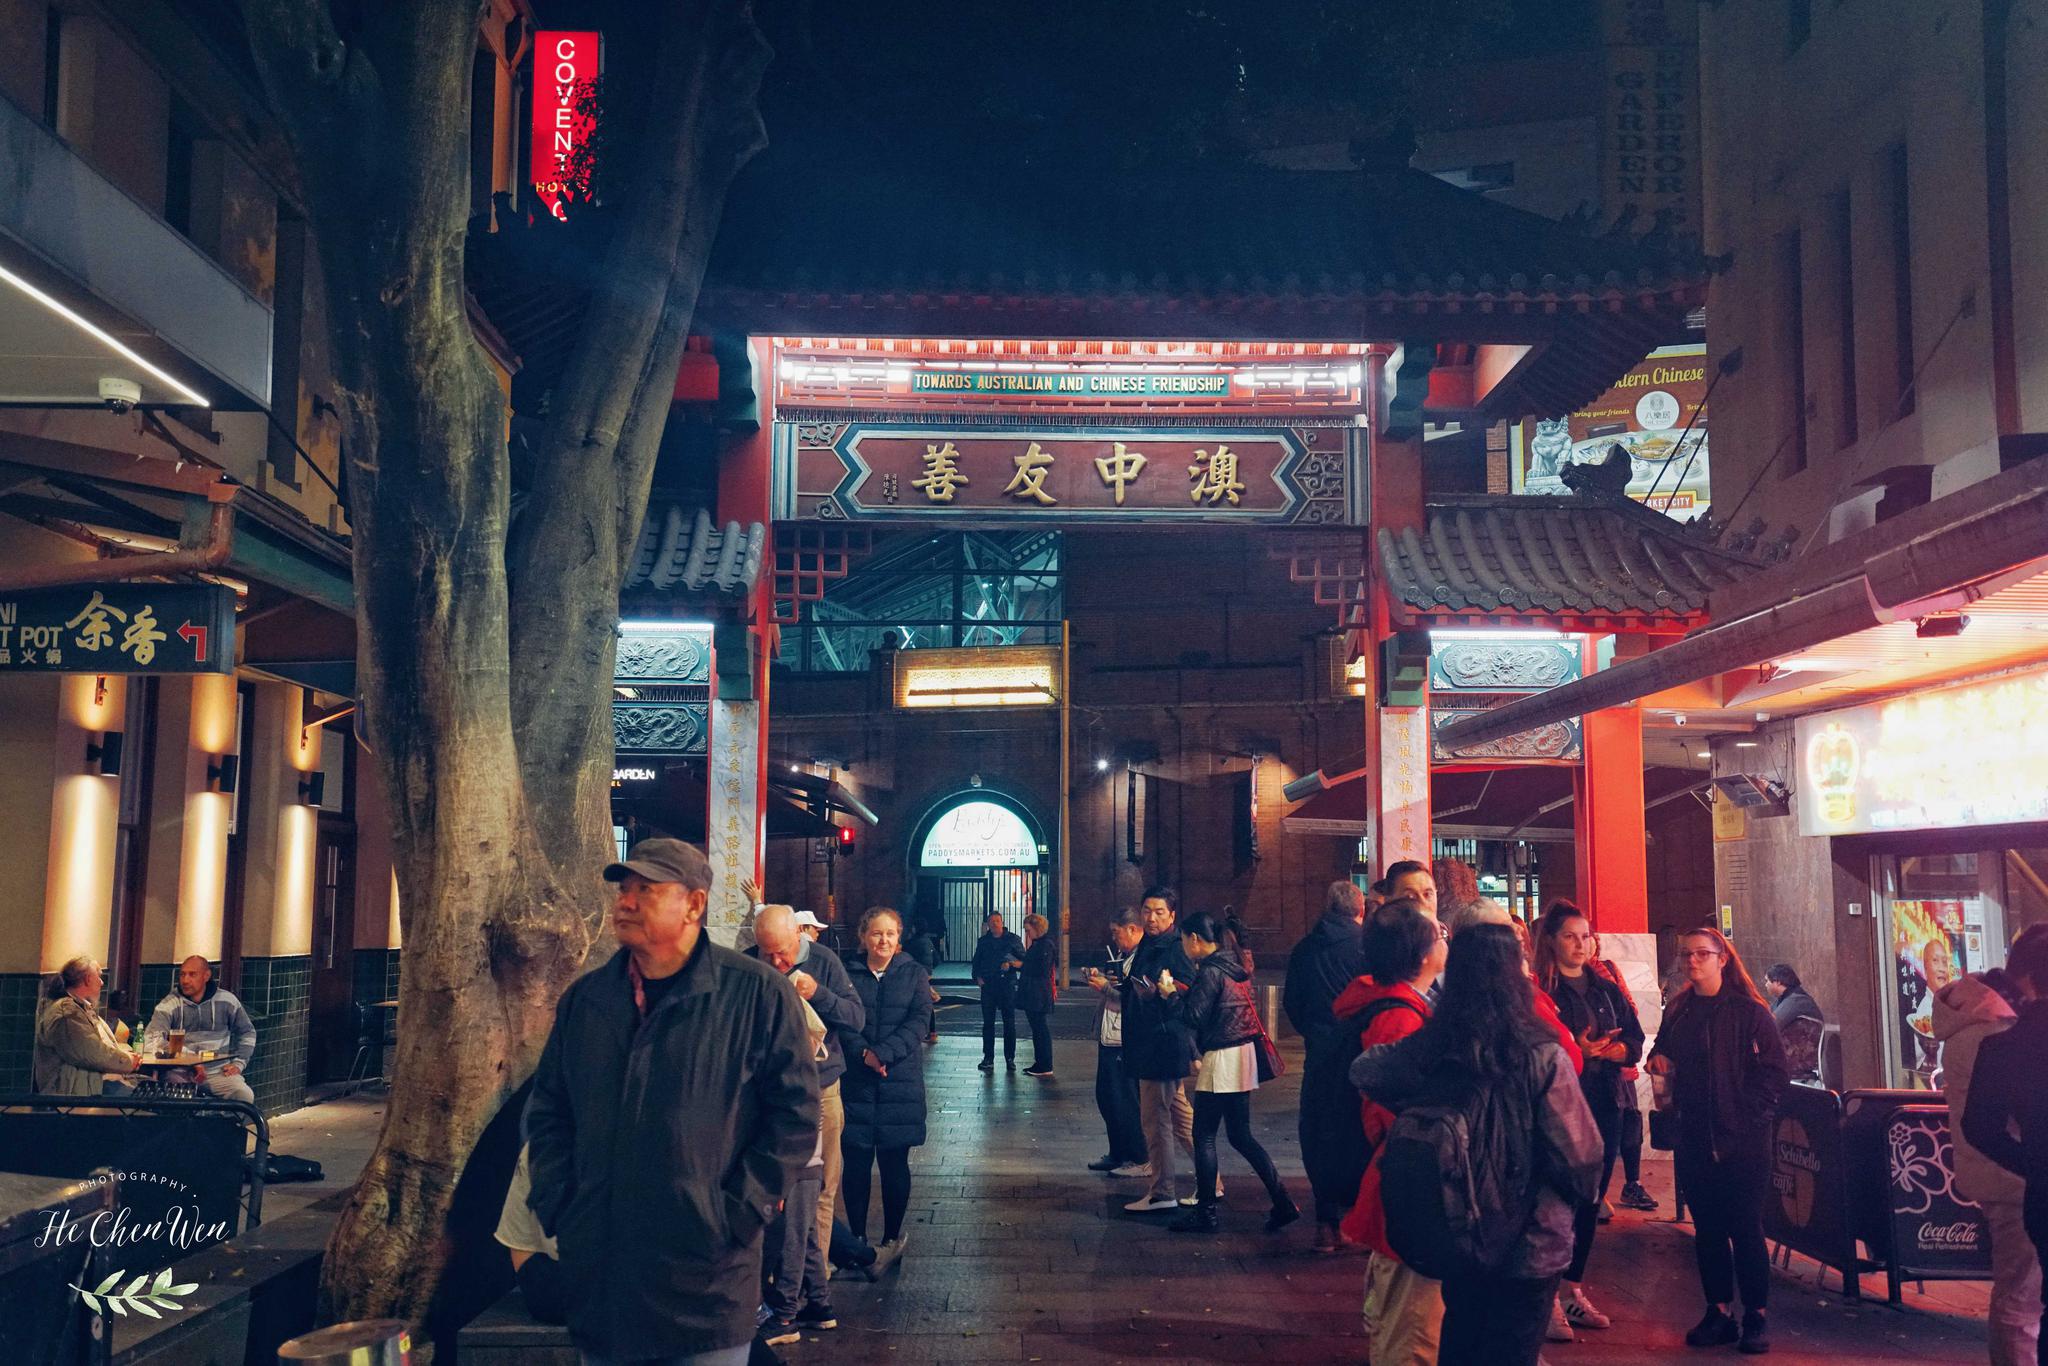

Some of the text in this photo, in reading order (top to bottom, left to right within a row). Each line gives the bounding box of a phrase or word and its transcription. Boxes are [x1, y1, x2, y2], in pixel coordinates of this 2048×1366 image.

[1653, 48, 1686, 193] EMPEROR
[1614, 71, 1647, 193] GARDEN
[914, 373, 1225, 392] TOWARDS AUSTRALIAN AND CHINESE FRIENDSHIP
[1652, 366, 1704, 385] Chinese
[1606, 408, 1630, 417] friends
[1672, 496, 1690, 506] CITY
[20, 626, 63, 649] POT
[928, 849, 1030, 857] PADDYSMARKETS.COM.AU
[1917, 1221, 1979, 1243] Coca-Cola
